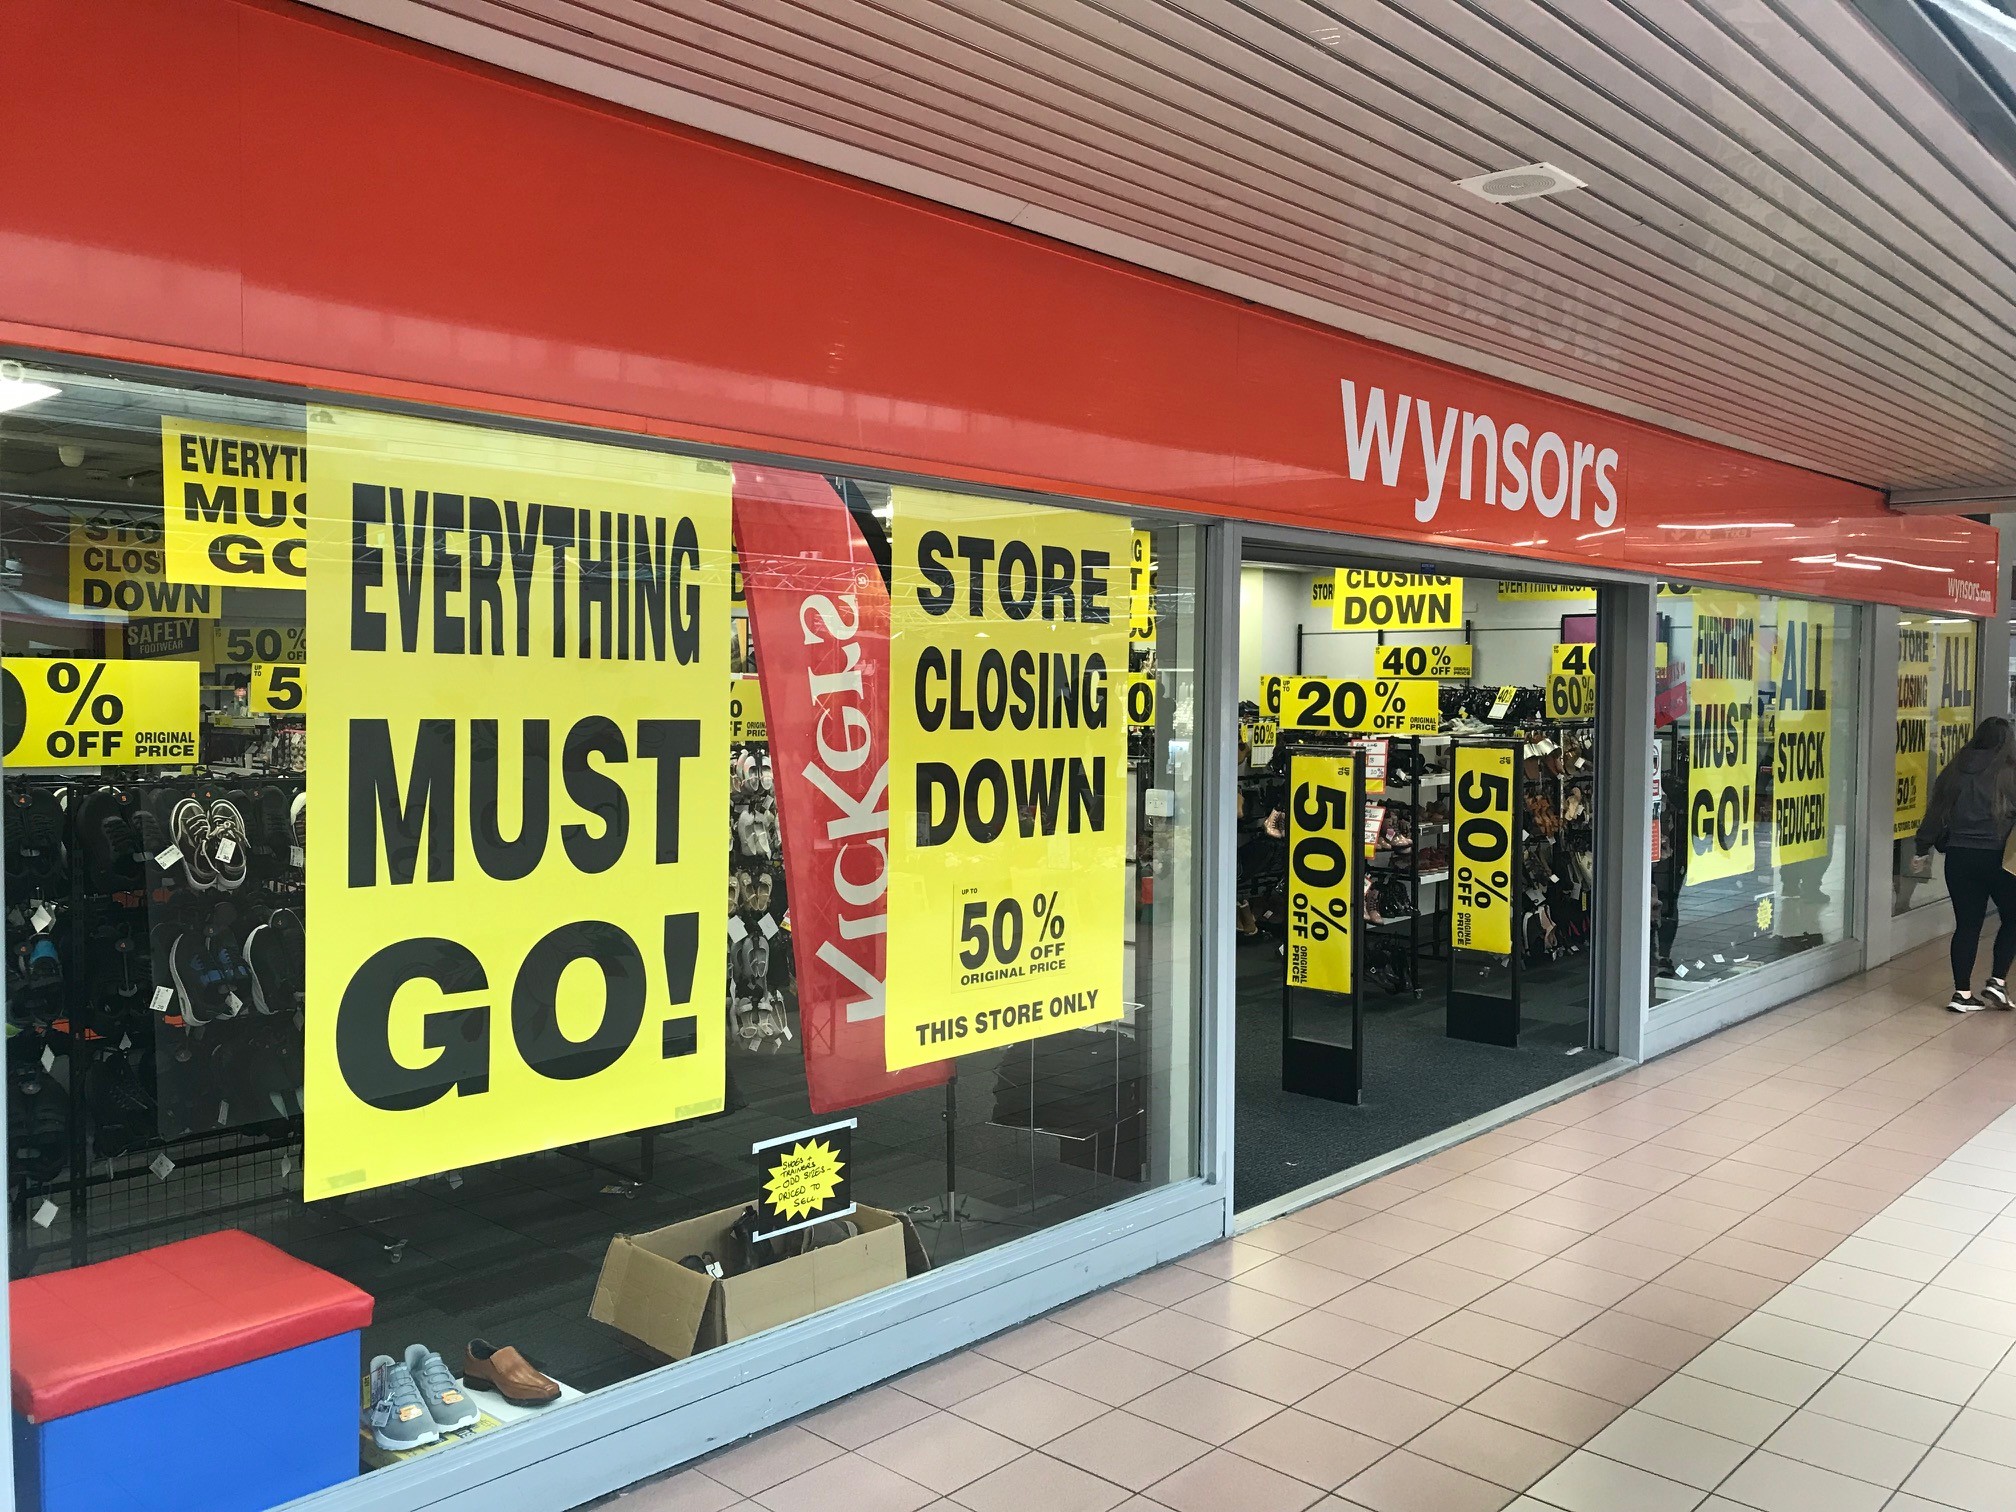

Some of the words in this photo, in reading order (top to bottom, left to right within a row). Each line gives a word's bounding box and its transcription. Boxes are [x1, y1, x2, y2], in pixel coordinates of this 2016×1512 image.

[1340, 378, 1619, 528] wynsors
[350, 482, 700, 666] EVERYTHING
[916, 531, 1111, 625] STORE
[1948, 577, 1991, 602] wynsors.com
[84, 578, 210, 613] DOWN
[1312, 583, 1334, 601] STOR
[1343, 593, 1452, 625] DOWN
[127, 619, 194, 645] SAFETY
[139, 639, 184, 654] FOOTWEAR
[1696, 614, 1754, 680] EVERYTHING
[1431, 667, 1451, 675] OFF
[1779, 620, 1826, 710] ALL
[1941, 636, 1971, 708] ALL
[914, 646, 1108, 732] CLOSING
[1897, 674, 1928, 708] LOSING
[1373, 715, 1406, 729] OFF
[1410, 716, 1437, 724] ORIGINAL
[1583, 703, 1594, 714] OFF
[46, 730, 123, 758] OFF
[134, 731, 195, 744] ORIGINAL
[134, 745, 195, 758] PRICE
[1693, 702, 1752, 769] MUST
[1338, 767, 1344, 776] TO
[1345, 767, 1350, 776] UP
[1499, 756, 1505, 764] TO
[1506, 756, 1511, 765] UP
[1777, 731, 1825, 783] STOCK
[348, 715, 700, 888] MUST
[915, 756, 1106, 848] DOWN
[1691, 785, 1750, 856] GO!
[1775, 793, 1825, 847] REDUCED!
[1458, 867, 1472, 907] OFF
[1293, 893, 1308, 939] OFF
[1030, 942, 1065, 960] OFF
[1300, 946, 1308, 984] ORIGINAL
[960, 967, 1025, 986] ORIGINAL
[1029, 959, 1066, 975] PRICE
[336, 911, 700, 1111] GO!
[915, 1017, 968, 1047] THIS
[974, 1000, 1043, 1034] STORE
[1050, 988, 1099, 1018] ONLY
[780, 1161, 816, 1177] TRAINERS
[783, 1157, 804, 1170] SHOES
[810, 1183, 821, 1191] TO
